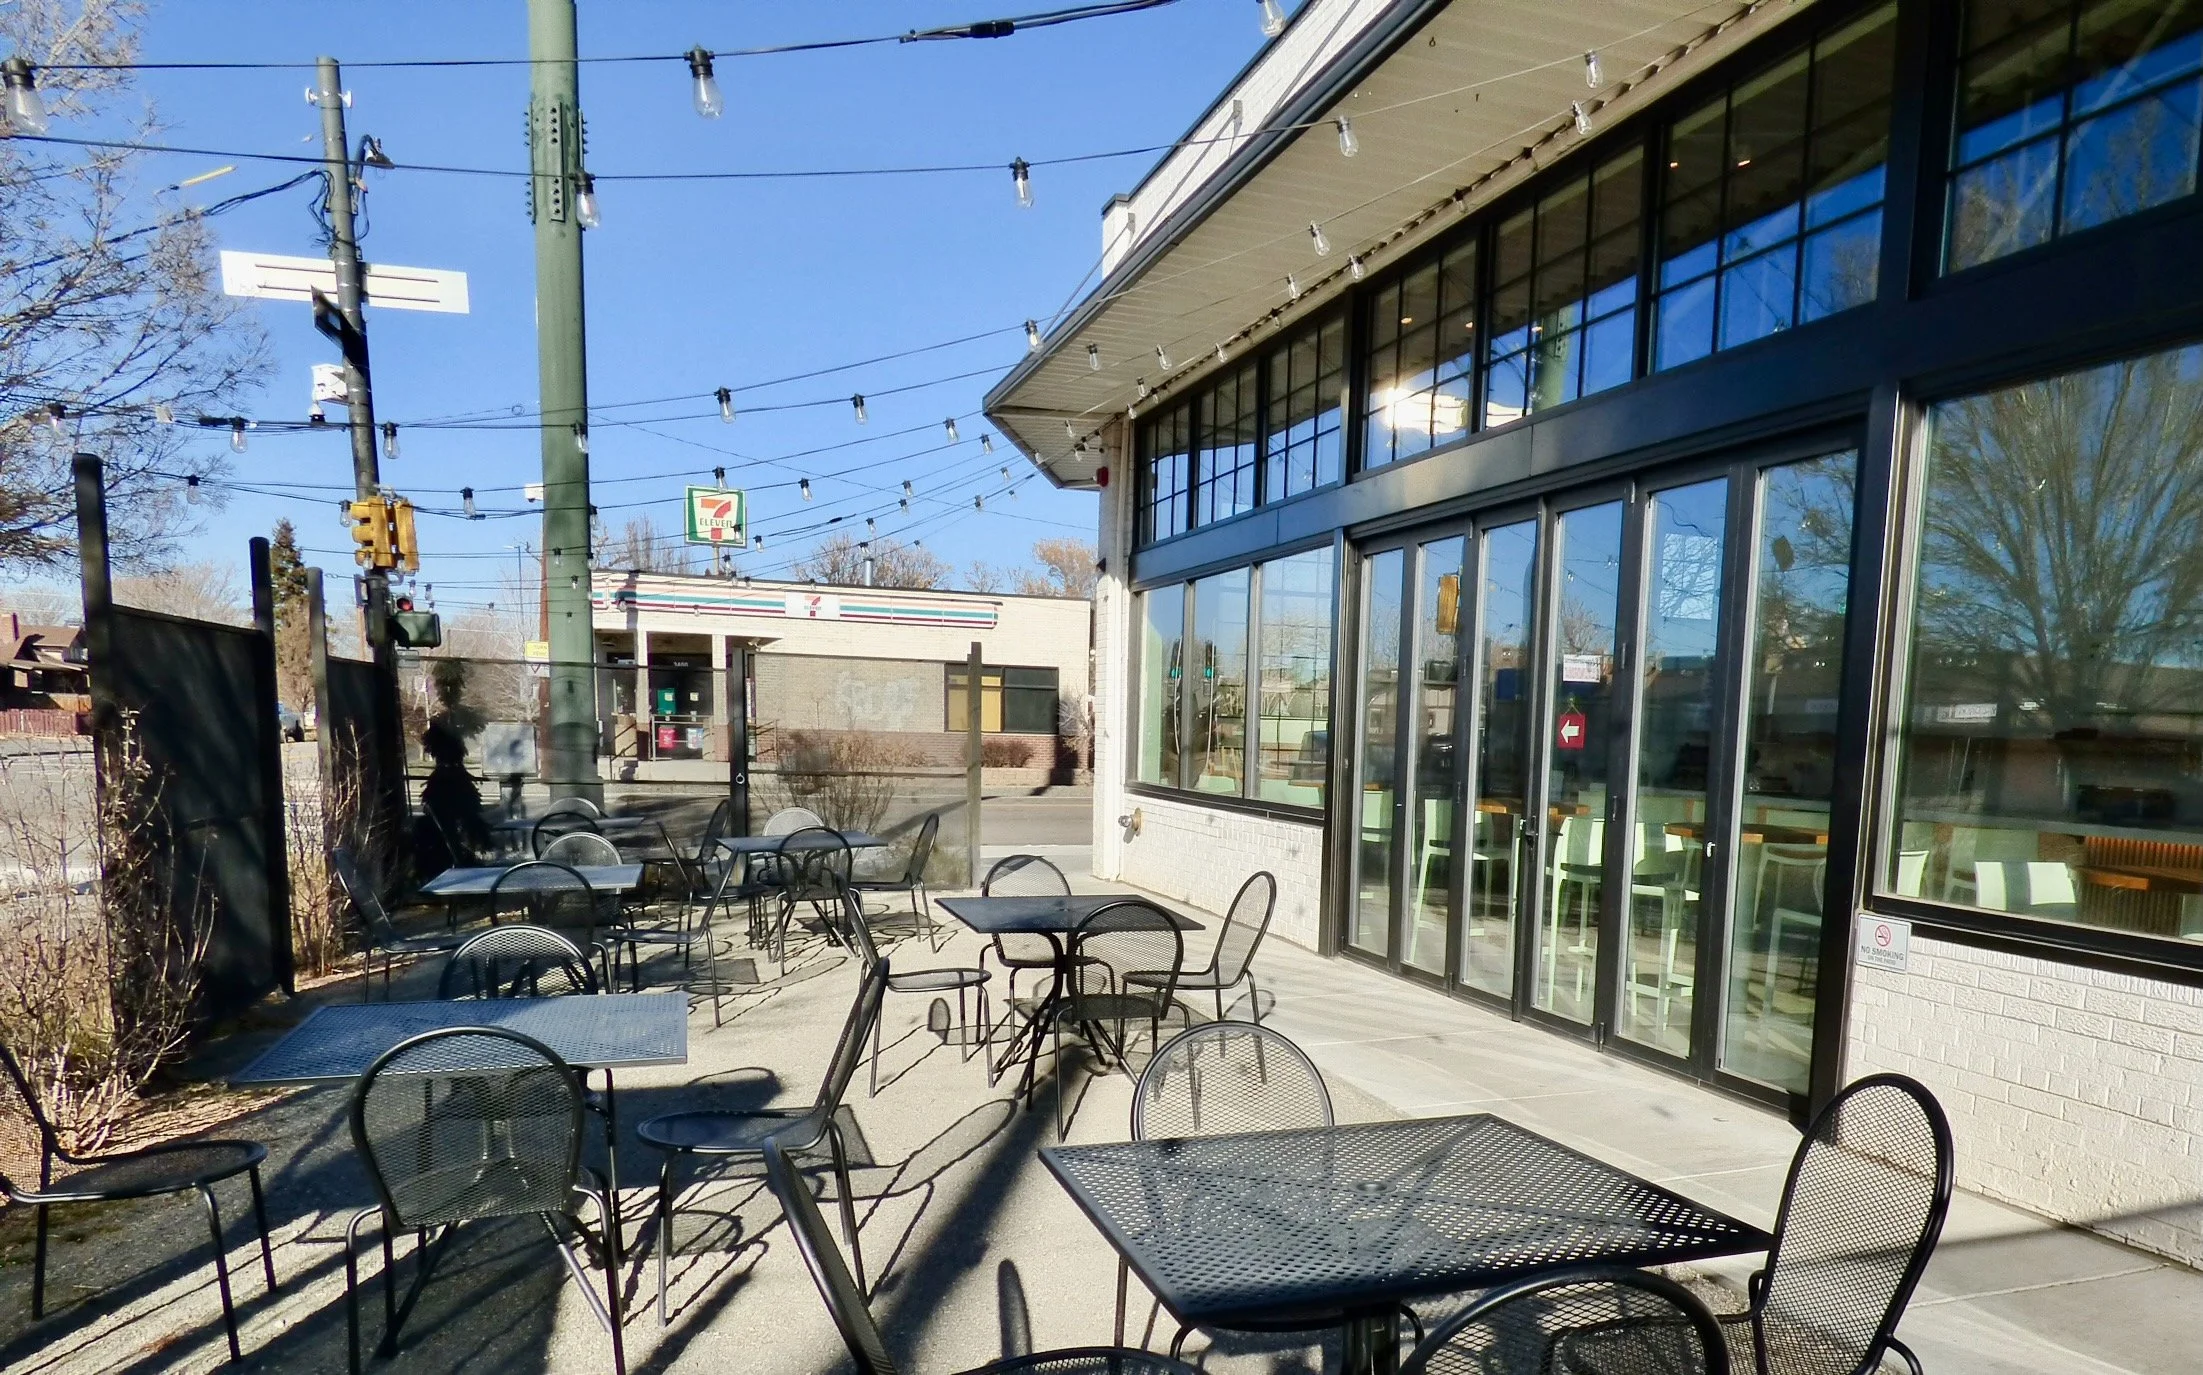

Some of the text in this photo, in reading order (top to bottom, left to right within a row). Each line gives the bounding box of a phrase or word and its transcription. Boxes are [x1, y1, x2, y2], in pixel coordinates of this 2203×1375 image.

[701, 498, 731, 540] 7
[1861, 945, 1904, 960] NO SMOKING
